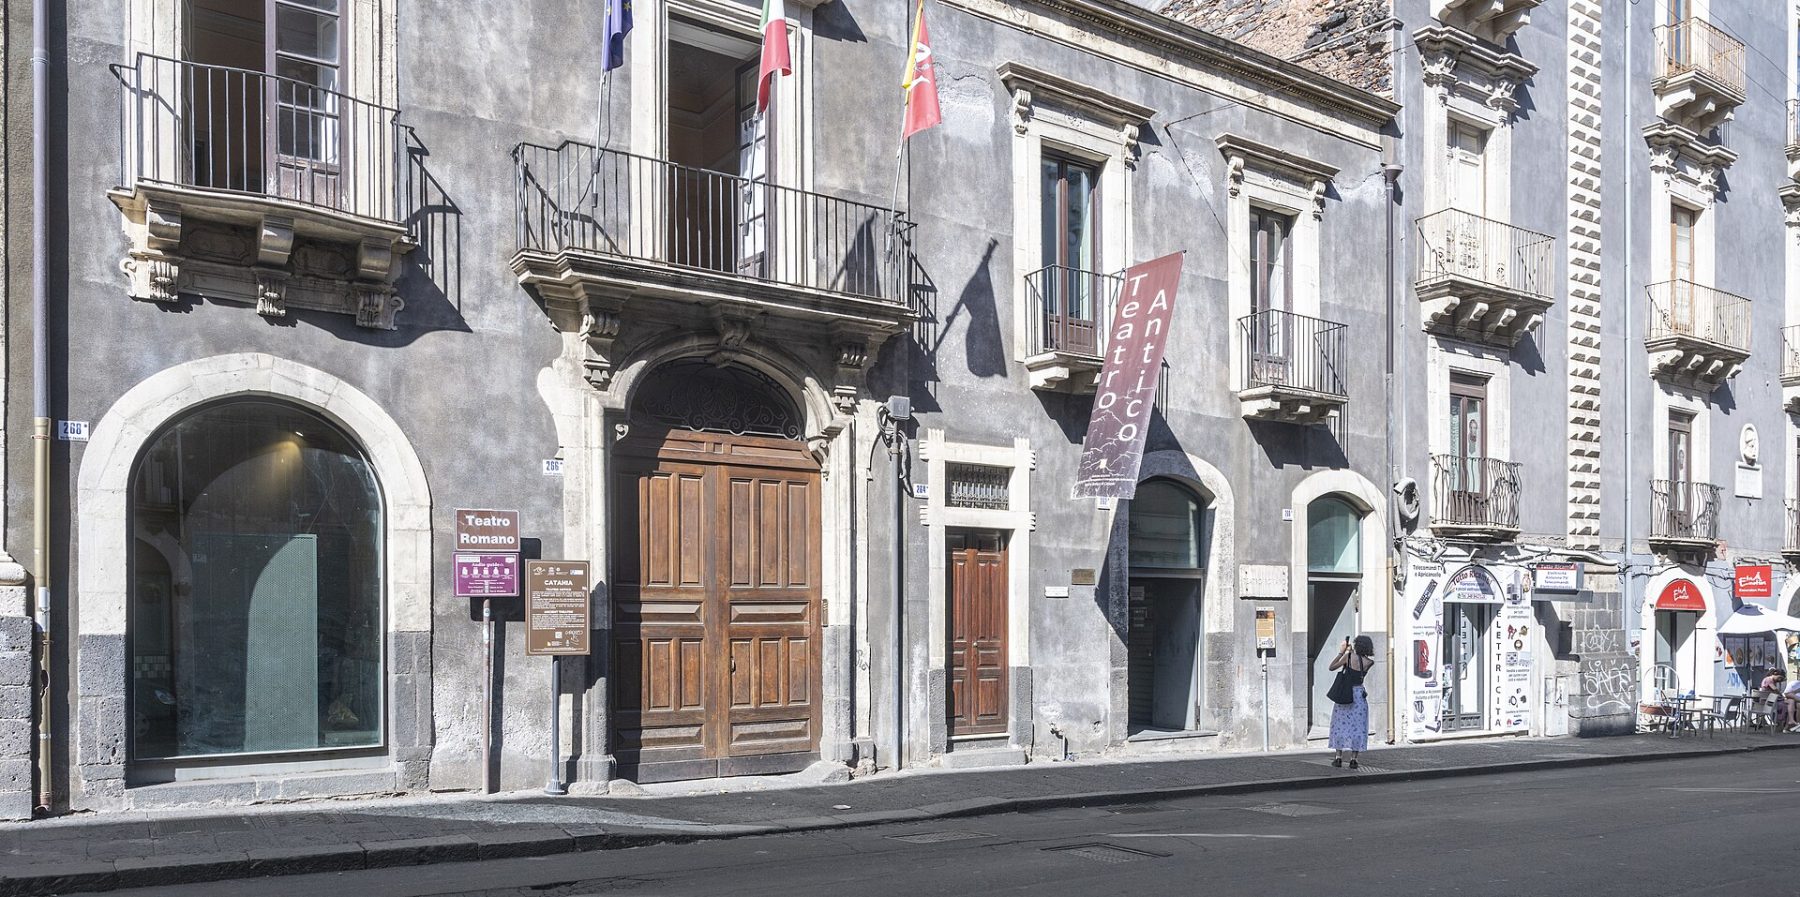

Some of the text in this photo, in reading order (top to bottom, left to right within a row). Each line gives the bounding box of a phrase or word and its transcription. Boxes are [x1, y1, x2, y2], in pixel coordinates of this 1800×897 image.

[1098, 273, 1148, 409] Teatro
[1119, 289, 1168, 442] Antico
[63, 422, 82, 434] 268
[546, 461, 559, 471] 266
[465, 515, 510, 526] Teatro
[460, 533, 515, 544] Romano
[1453, 572, 1468, 585] Tutto
